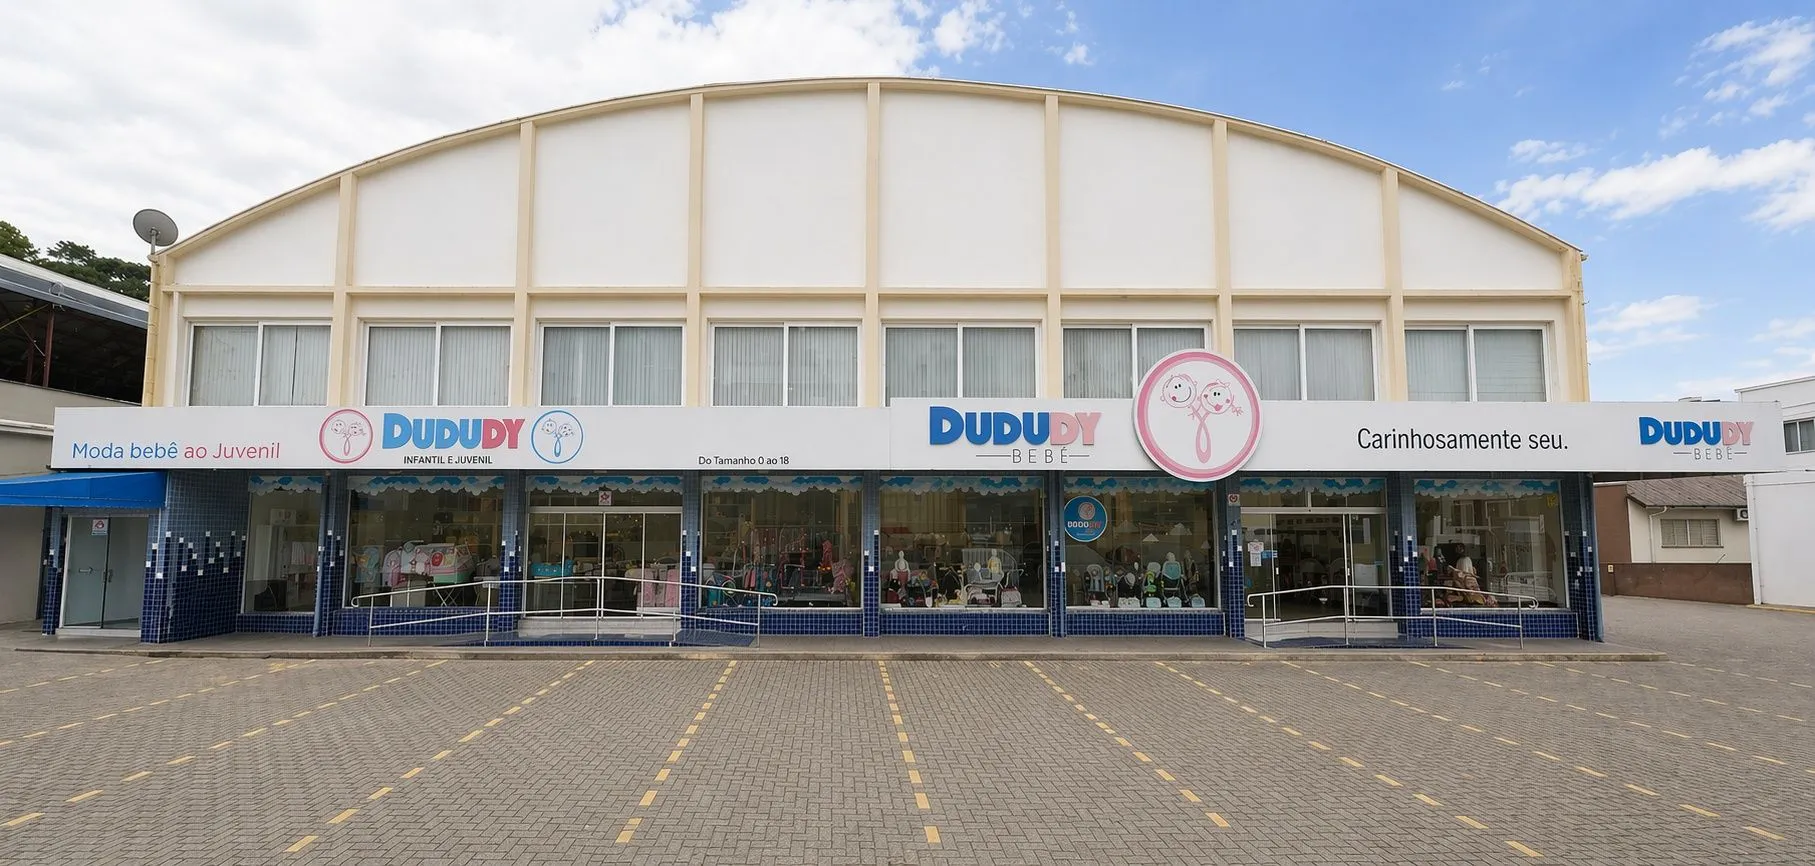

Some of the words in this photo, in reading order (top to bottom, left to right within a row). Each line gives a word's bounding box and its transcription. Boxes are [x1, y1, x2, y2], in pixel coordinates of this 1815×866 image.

[382, 412, 526, 450] DUDUDY
[929, 406, 1102, 446] DUDUDY
[1638, 416, 1755, 446] DUDUDY
[72, 442, 124, 459] Moda
[130, 441, 179, 459] bebê
[184, 446, 207, 459] ao
[212, 442, 280, 459] Juvenil
[1357, 427, 1522, 450] Carinhosamente
[1528, 433, 1569, 450] seu.
[403, 455, 446, 464] INFANTIL
[447, 455, 453, 464] E
[454, 455, 493, 464] JUVENIL
[698, 456, 712, 465] Do
[713, 456, 756, 465] Tamanho
[757, 456, 765, 465] 0
[766, 457, 778, 465] ao
[779, 456, 790, 465] 18
